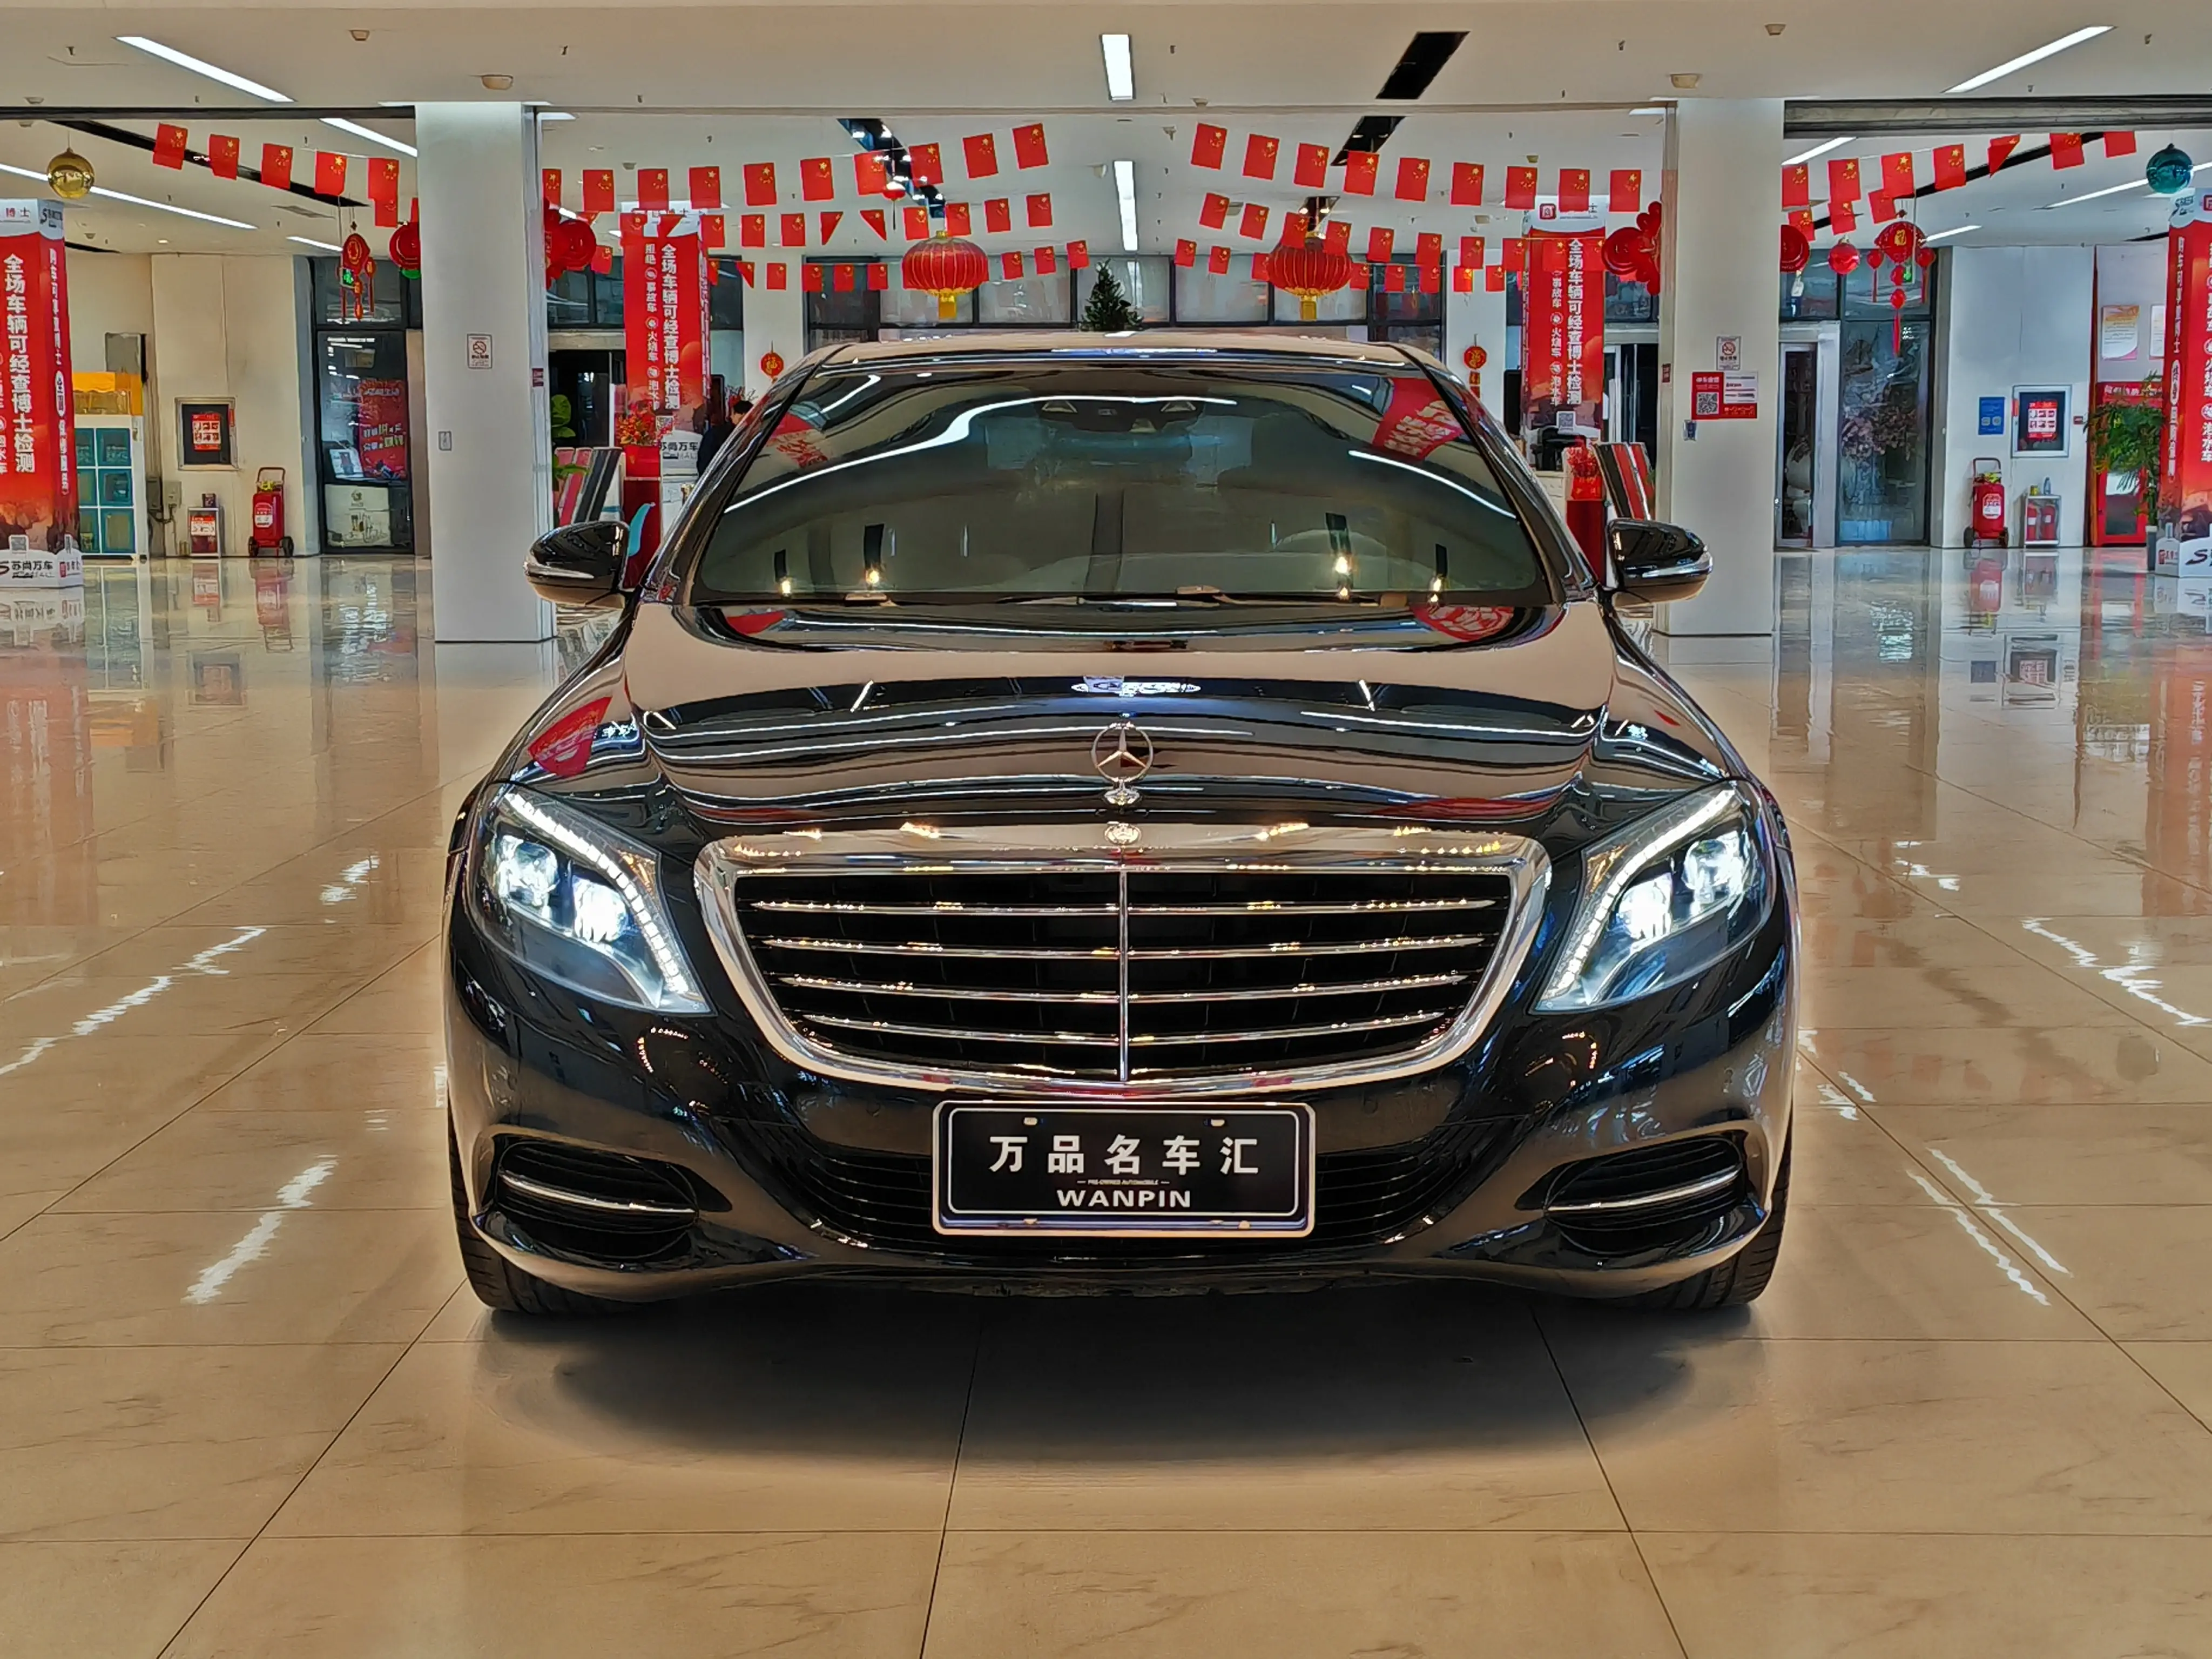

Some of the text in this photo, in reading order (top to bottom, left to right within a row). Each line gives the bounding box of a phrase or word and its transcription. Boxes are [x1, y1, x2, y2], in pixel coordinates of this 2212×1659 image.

[3, 253, 35, 473] 全场车辆可经查博士检测
[661, 244, 680, 409] 全场车辆可经查博士检测
[1567, 239, 1583, 405] 全场车辆可经查博士检测
[989, 1134, 1258, 1175] 万品名车汇
[1057, 1190, 1191, 1208] WANPIN
